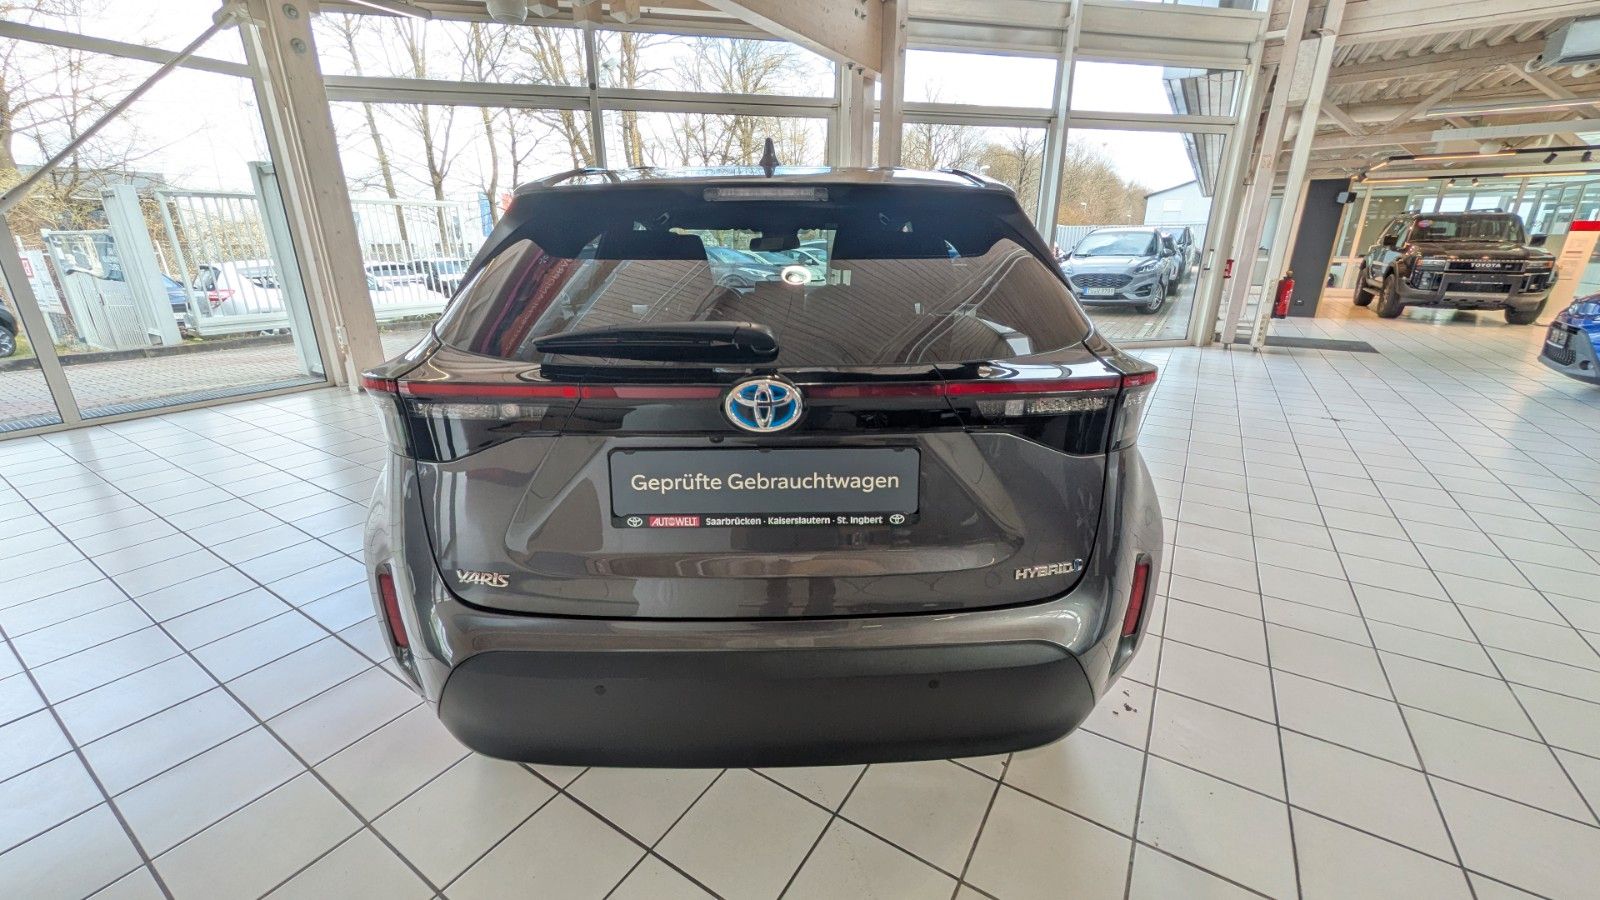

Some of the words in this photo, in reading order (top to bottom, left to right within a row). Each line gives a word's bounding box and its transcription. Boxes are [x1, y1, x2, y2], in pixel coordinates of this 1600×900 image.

[630, 472, 722, 494] Geprüfte
[727, 471, 900, 494] Gebrauchtwagen
[706, 516, 762, 525] Saarbrücken
[768, 515, 831, 525] Kaiserslautern
[836, 515, 849, 524] St.
[850, 515, 883, 525] Ingbert
[1015, 562, 1074, 580] HYBRID
